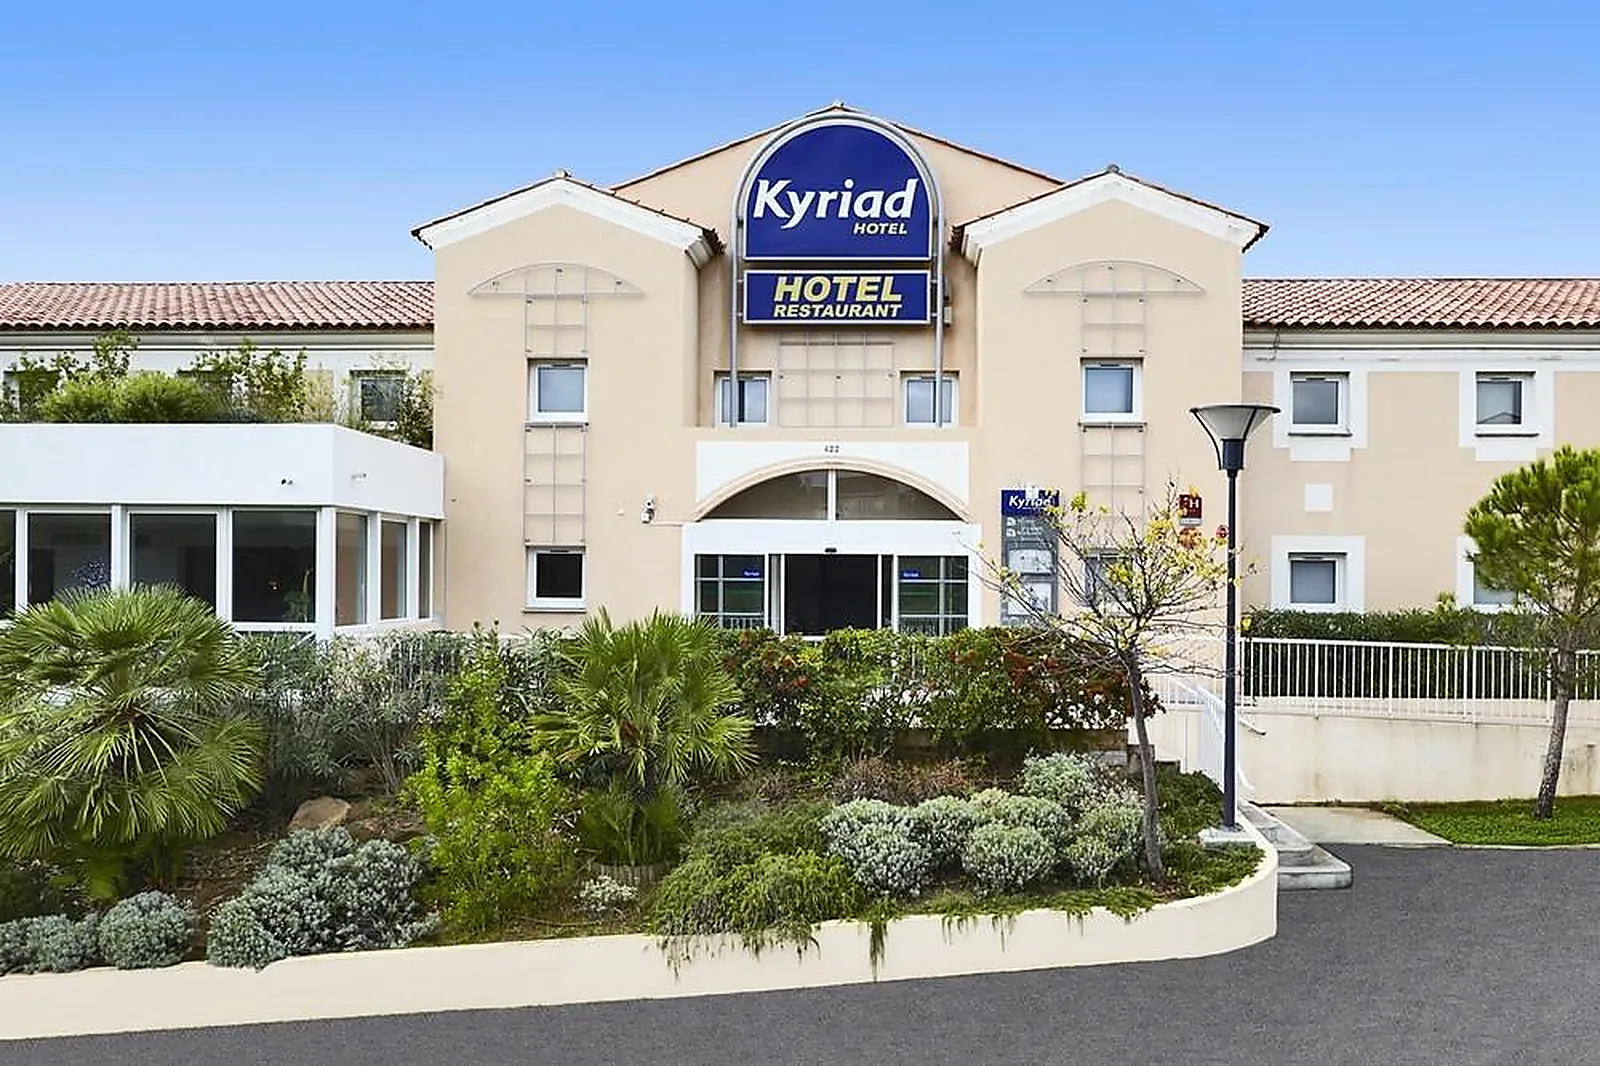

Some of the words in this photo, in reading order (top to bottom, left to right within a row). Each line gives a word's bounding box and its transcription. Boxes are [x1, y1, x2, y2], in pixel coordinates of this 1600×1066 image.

[753, 178, 918, 229] Kyriad
[853, 222, 908, 235] HOTEL
[773, 275, 902, 302] HOTEL
[773, 303, 903, 318] RESTAURANT
